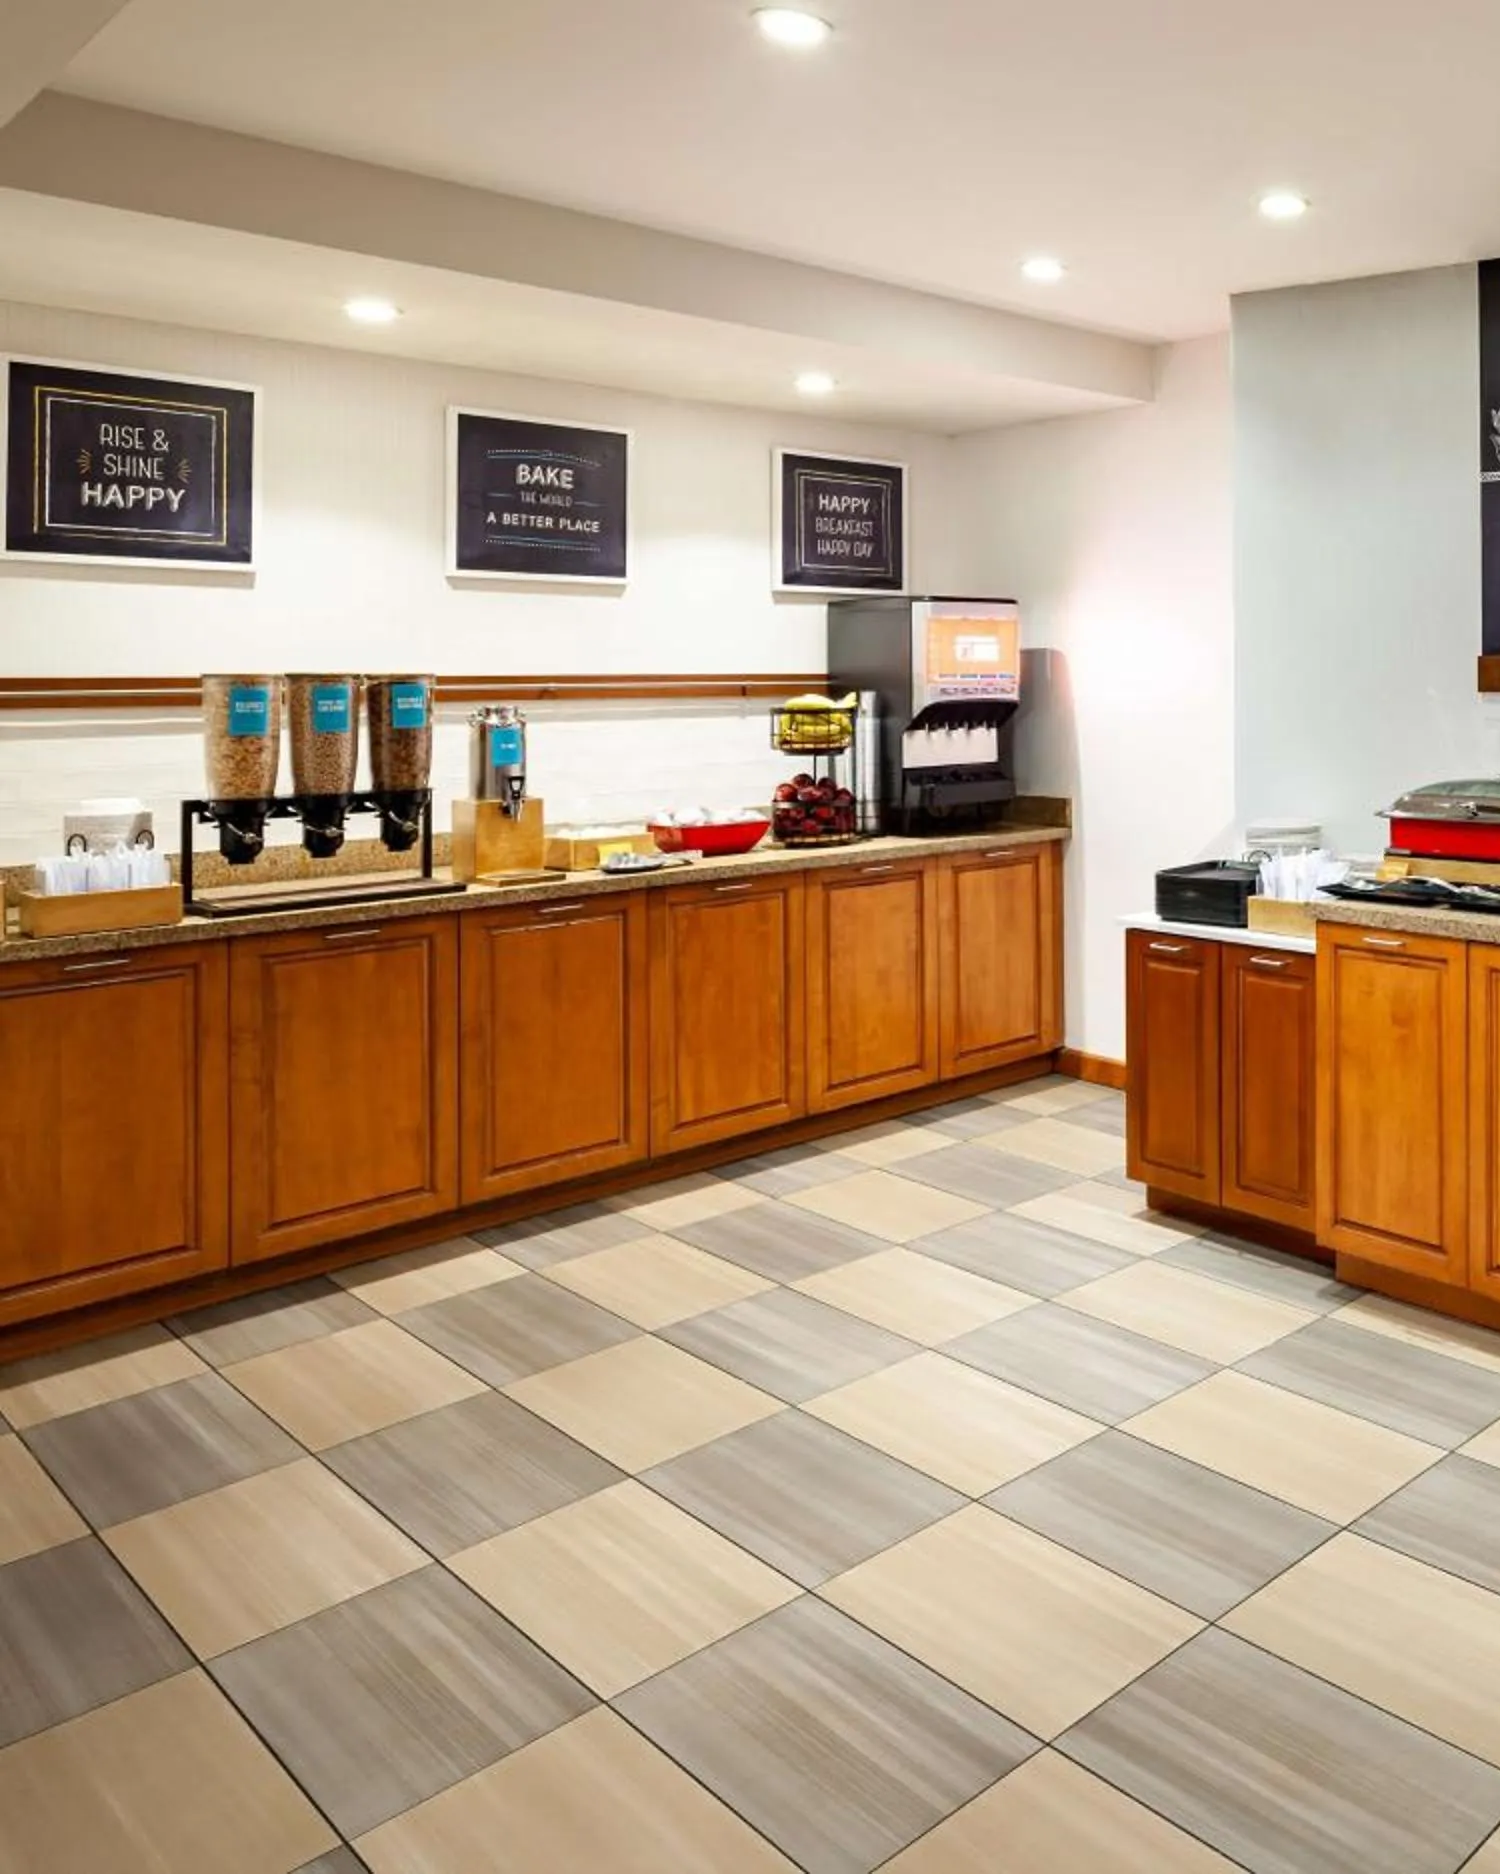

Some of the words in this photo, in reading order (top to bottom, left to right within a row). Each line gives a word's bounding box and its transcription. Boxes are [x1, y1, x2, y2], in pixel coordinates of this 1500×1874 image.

[99, 422, 145, 451] RISE
[151, 429, 170, 452] &
[103, 453, 164, 480] SHINE
[516, 463, 574, 489] BAKE
[81, 481, 186, 512] HAPPY
[819, 493, 870, 514] HAPPY
[487, 511, 496, 523] A
[502, 513, 553, 528] BETTER
[559, 518, 600, 532] PLACE
[815, 517, 873, 536] BREAKFAST
[817, 539, 850, 556] HAPPY
[853, 541, 874, 558] DAY
